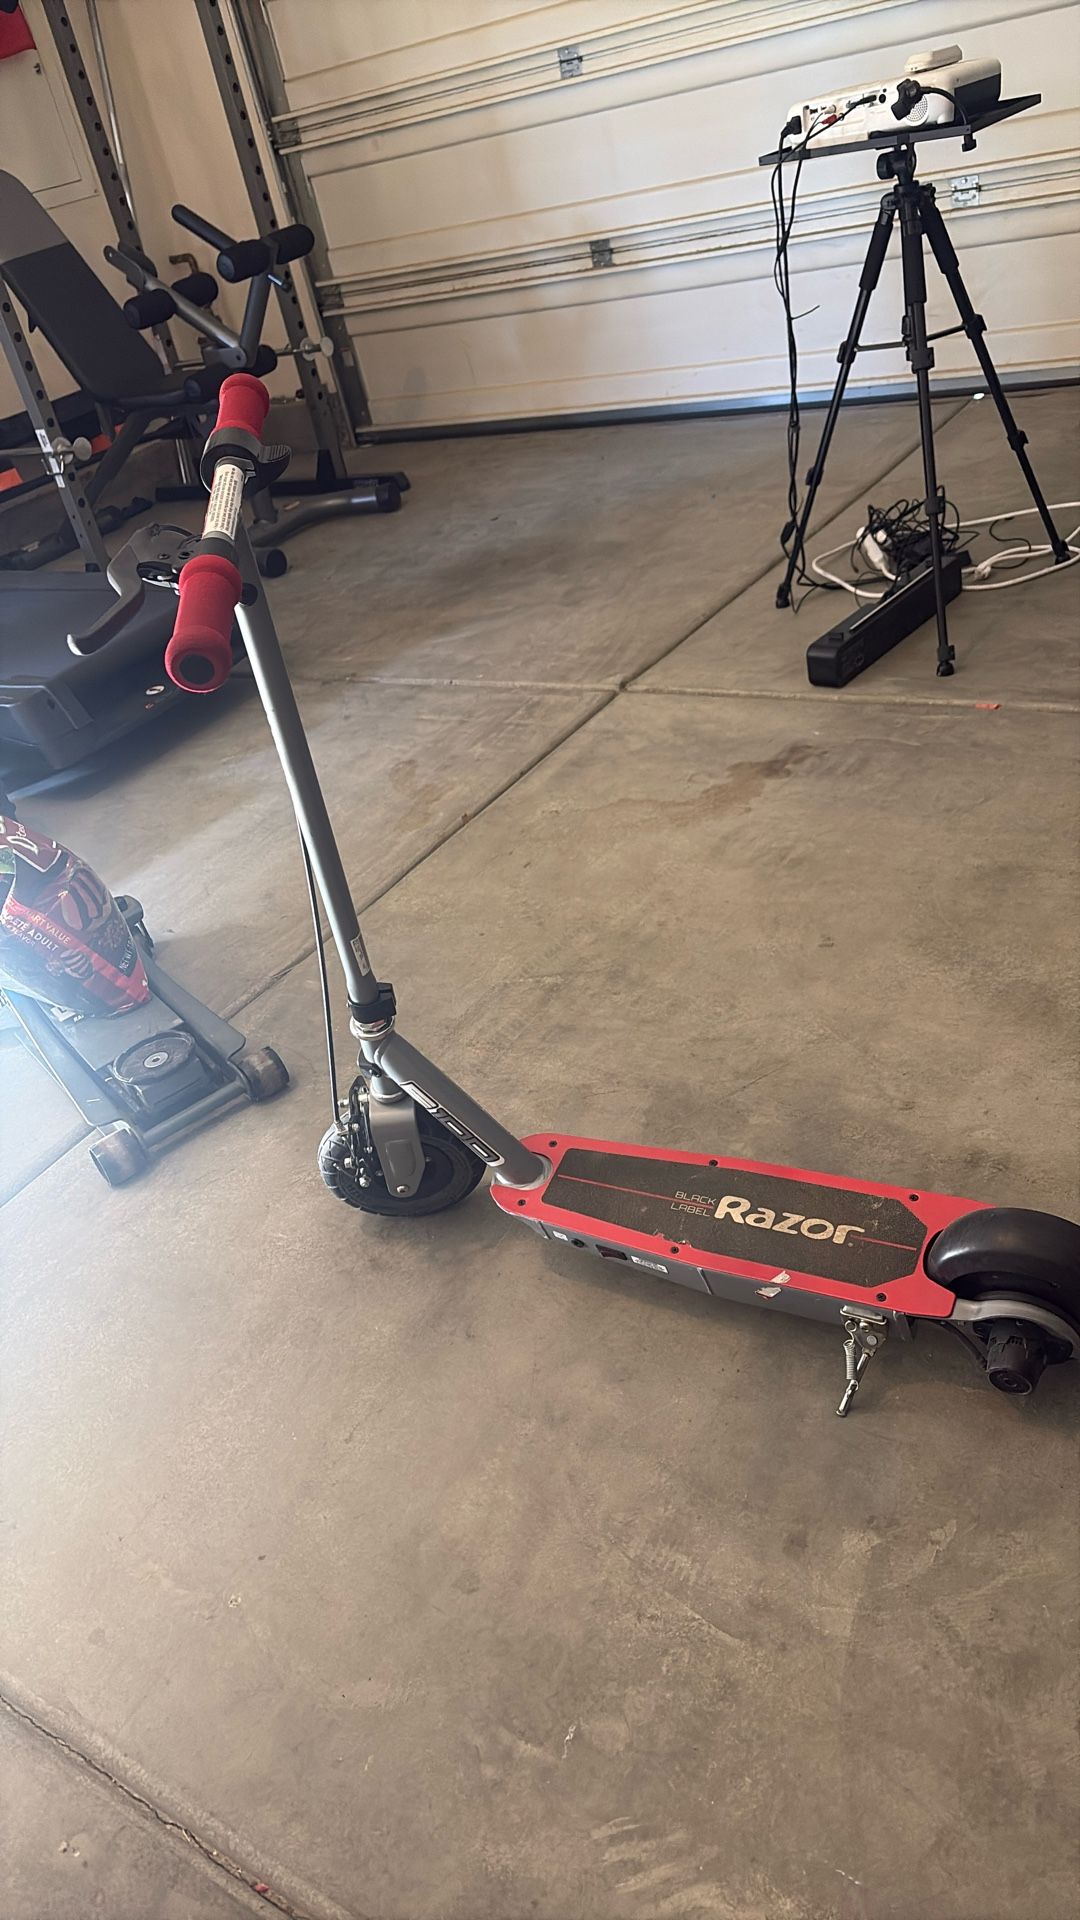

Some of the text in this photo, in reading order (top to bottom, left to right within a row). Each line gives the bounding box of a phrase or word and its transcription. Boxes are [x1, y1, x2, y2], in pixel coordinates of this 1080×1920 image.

[27, 928, 59, 951] ADULT
[46, 922, 71, 944] VALUE
[675, 1191, 717, 1205] BLACK
[671, 1203, 711, 1217] LABEL
[714, 1195, 865, 1244] Razor
